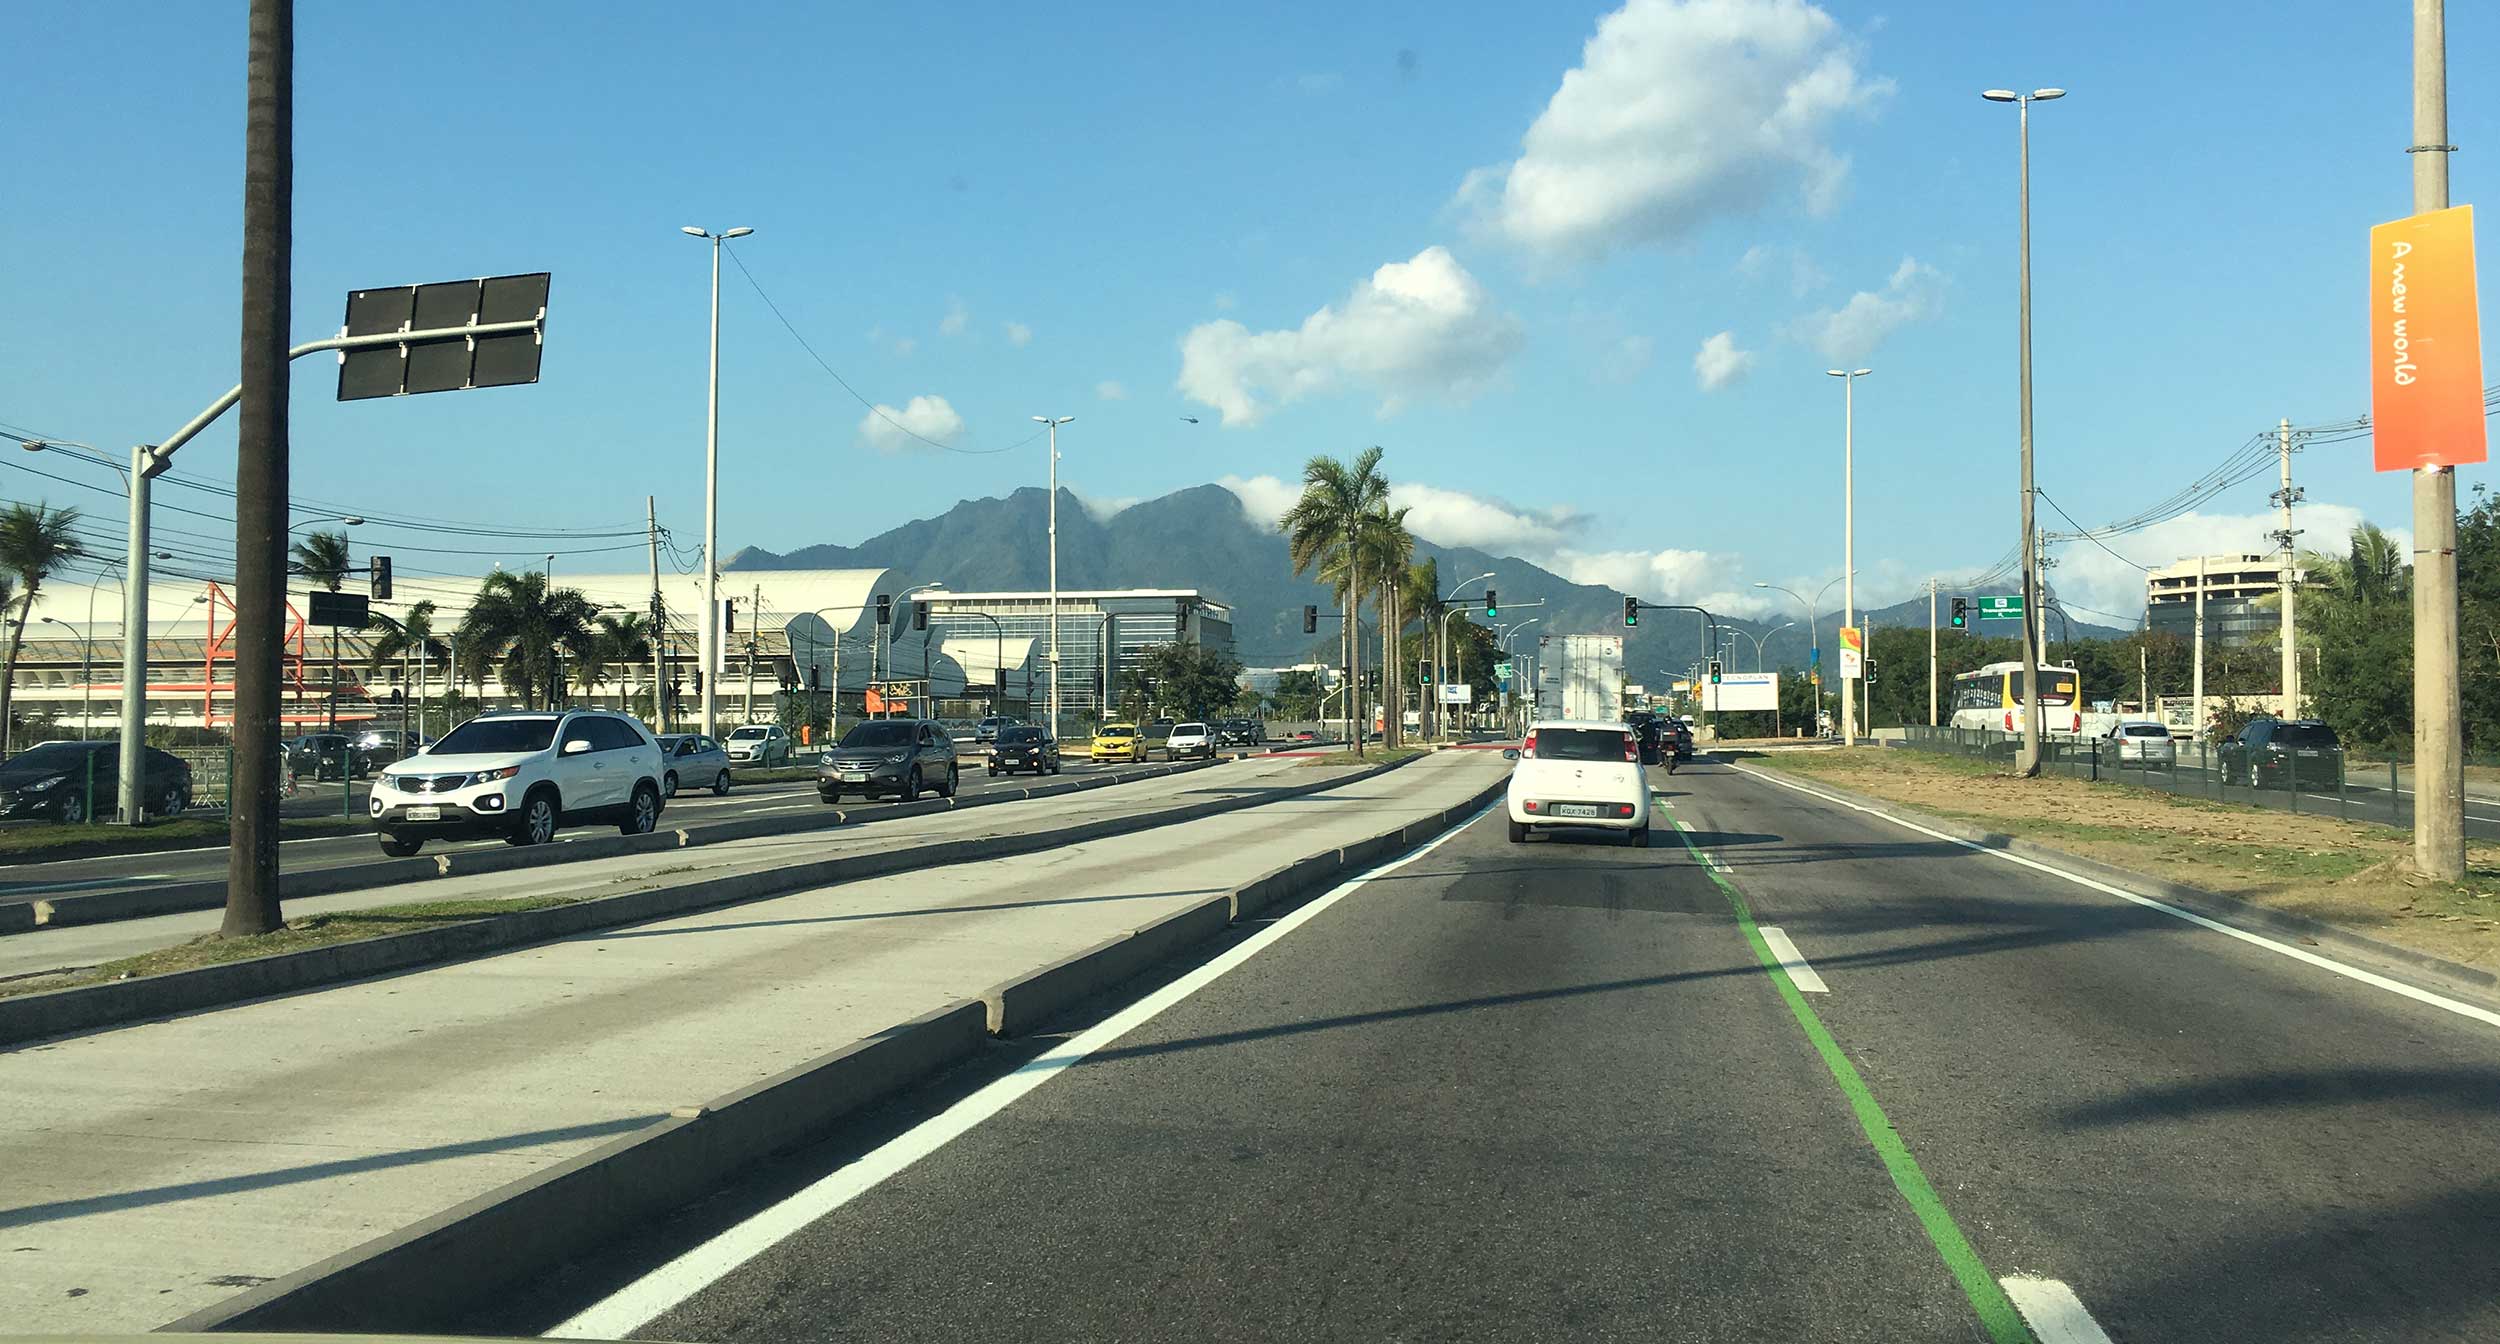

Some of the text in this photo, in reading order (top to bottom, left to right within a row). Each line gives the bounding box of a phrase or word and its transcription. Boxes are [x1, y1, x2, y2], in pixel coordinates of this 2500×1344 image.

[2391, 241, 2417, 386] A new world
